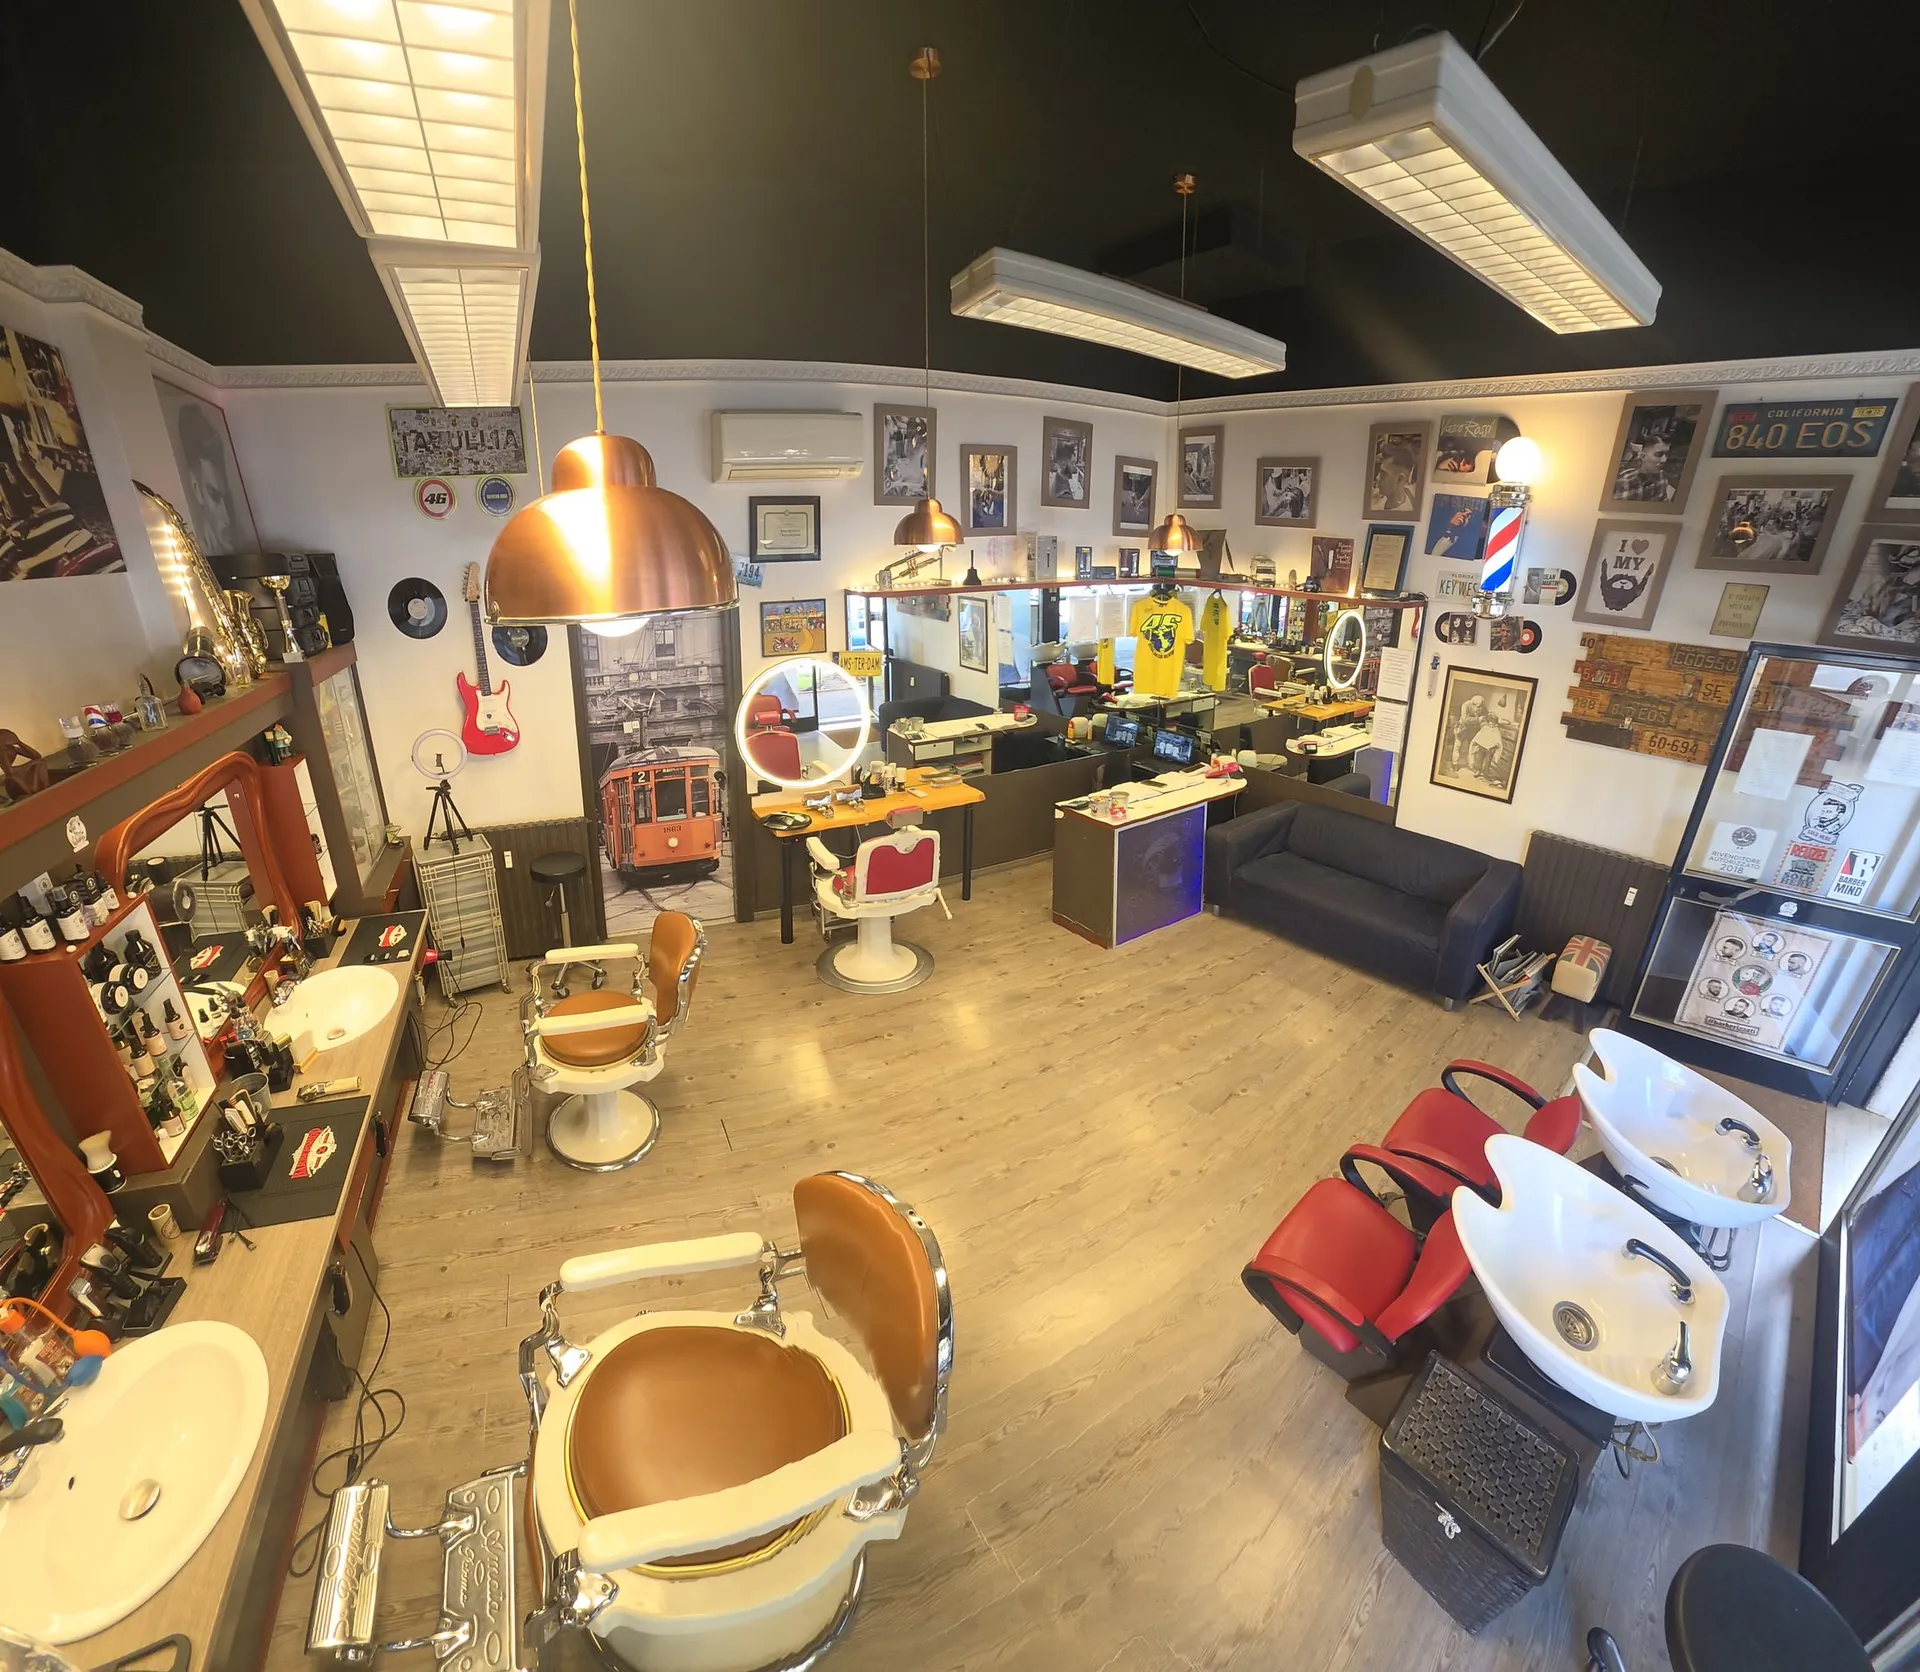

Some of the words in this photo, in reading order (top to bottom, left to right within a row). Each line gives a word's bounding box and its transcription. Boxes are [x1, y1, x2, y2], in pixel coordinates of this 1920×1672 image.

[1767, 407, 1844, 419] CALIFORNIA
[1726, 423, 1788, 450] 840
[1795, 420, 1876, 449] EOS
[424, 493, 447, 504] 46
[1618, 539, 1628, 553] I
[1612, 556, 1645, 571] MY
[1438, 579, 1458, 595] KEY
[1458, 580, 1478, 597] WES
[1140, 613, 1182, 638] 46
[1702, 683, 1726, 699] SE
[637, 771, 646, 783] 2
[663, 825, 682, 834] 1863
[1708, 856, 1761, 870] AUTORIZZATO
[1711, 850, 1761, 864] RIVENDITORE
[1720, 863, 1744, 875] 2018
[1784, 871, 1815, 883] SOLD
[1839, 875, 1867, 888] BARBER
[1833, 882, 1863, 897] MIND
